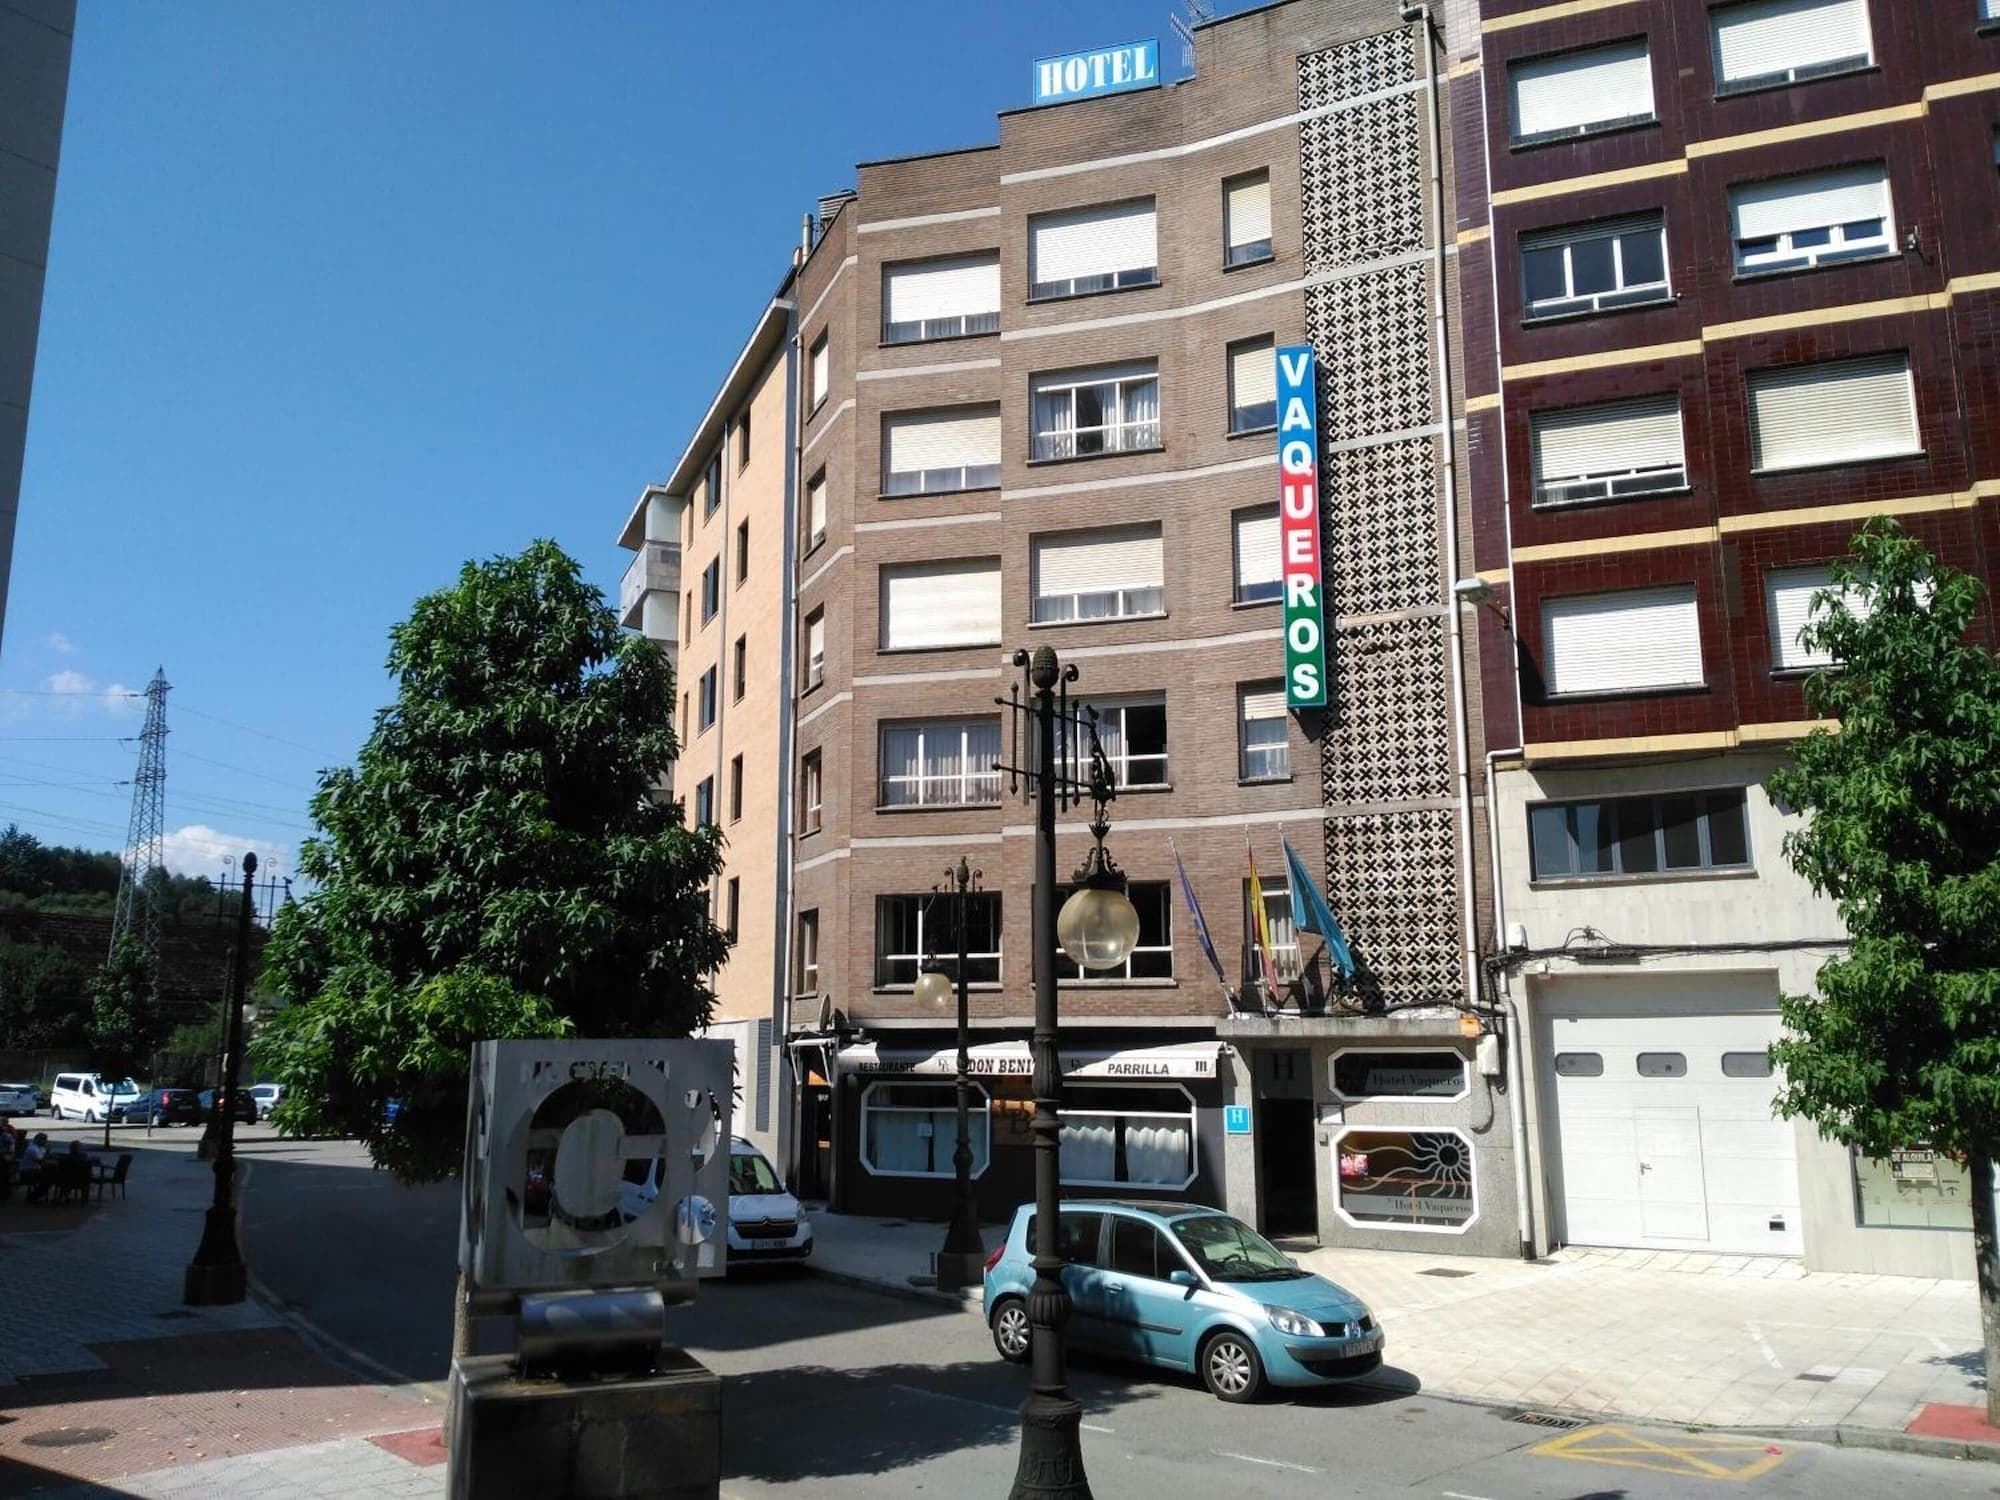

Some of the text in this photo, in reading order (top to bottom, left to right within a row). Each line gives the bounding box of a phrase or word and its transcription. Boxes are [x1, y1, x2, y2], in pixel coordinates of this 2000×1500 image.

[1038, 46, 1154, 97] HOTEL
[1280, 353, 1320, 701] VAQUEROS
[1000, 1058, 1036, 1073] BENI
[1108, 1063, 1170, 1075] PARRILLA
[1231, 1109, 1244, 1124] H
